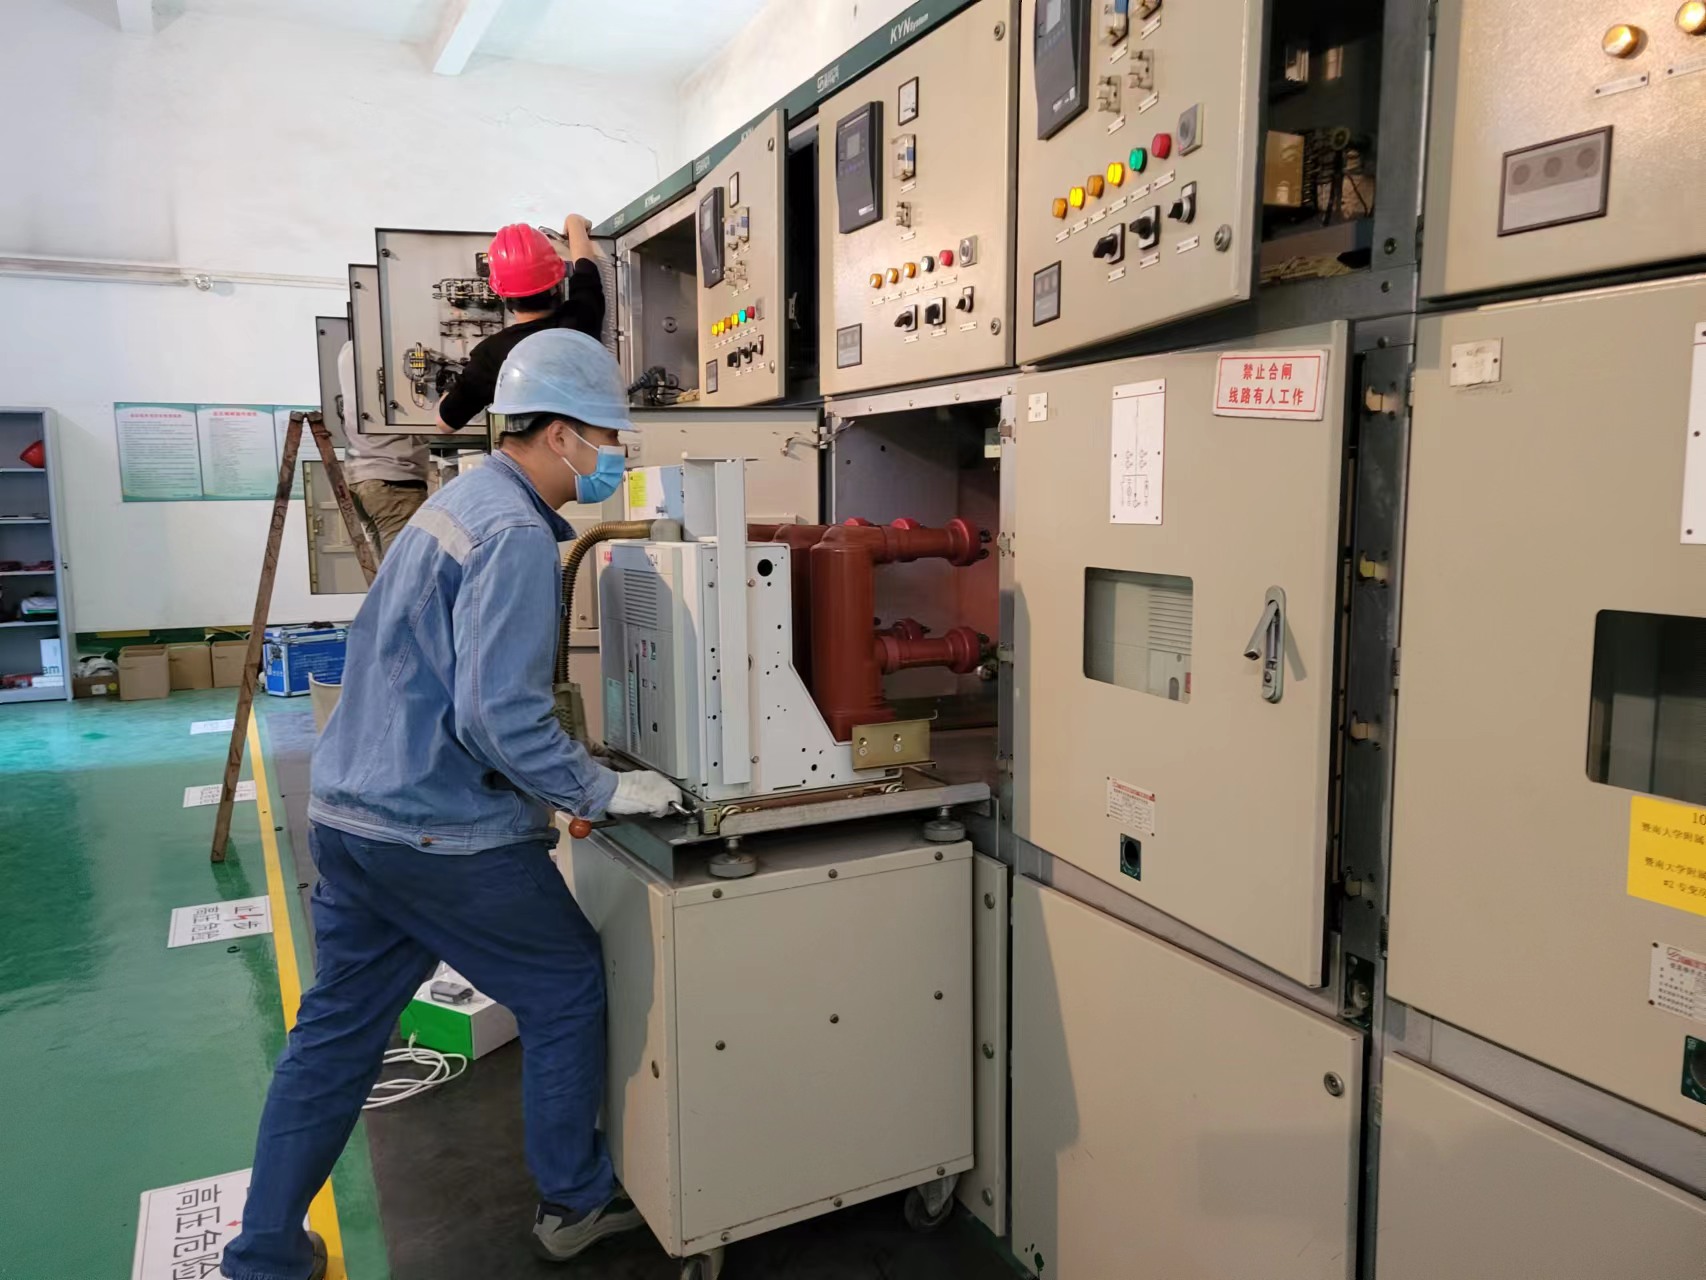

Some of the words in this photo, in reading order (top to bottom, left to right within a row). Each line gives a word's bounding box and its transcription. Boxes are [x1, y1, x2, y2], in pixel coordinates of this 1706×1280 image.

[890, 16, 911, 45] KYN
[1242, 362, 1293, 381] 禁止合闸
[1228, 387, 1305, 406] 线路有人工作
[192, 905, 221, 942] 高压危险
[171, 1184, 223, 1280] 高压危险
